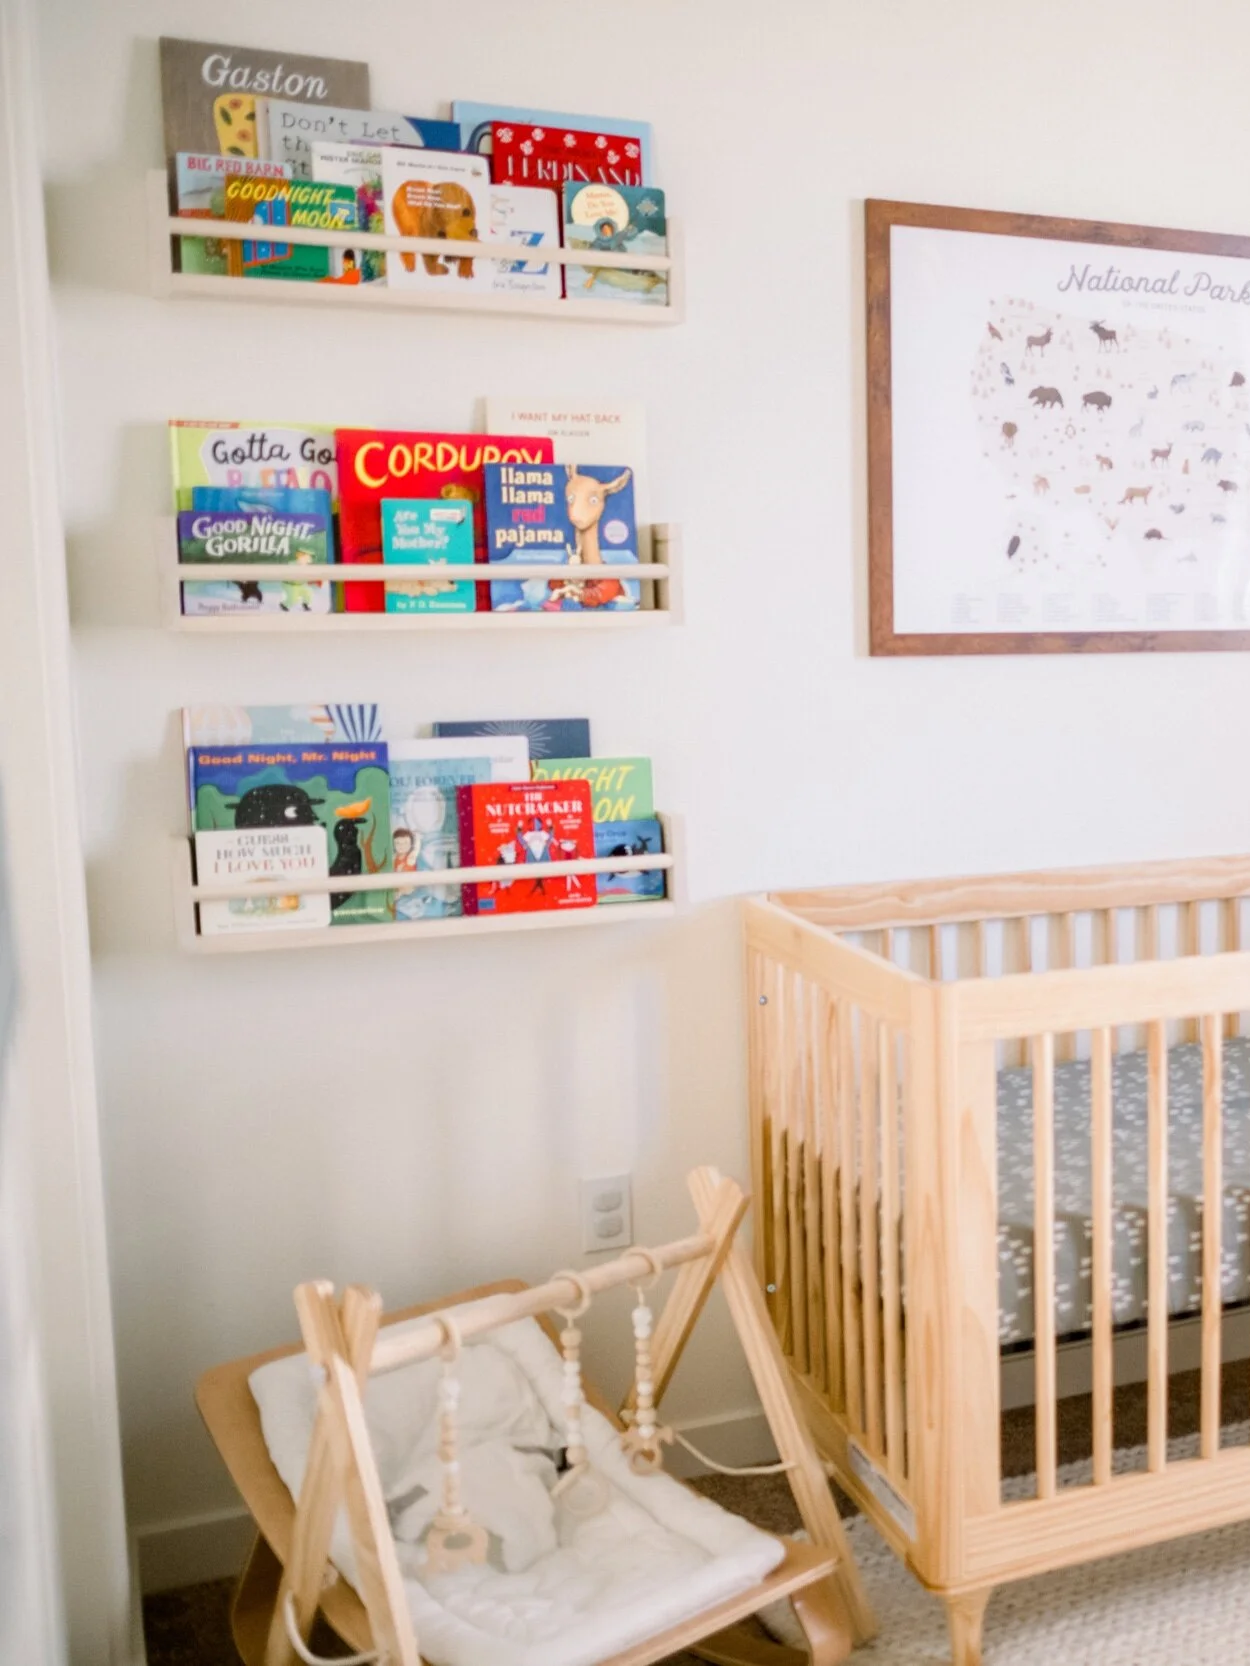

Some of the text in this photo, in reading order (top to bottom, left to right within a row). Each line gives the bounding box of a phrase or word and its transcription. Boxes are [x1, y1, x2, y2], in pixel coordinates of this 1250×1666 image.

[203, 54, 328, 98] Gaston
[281, 112, 400, 141] Don't Let
[282, 135, 312, 152] th
[187, 156, 284, 177] BIG RED BARN
[227, 181, 337, 205] GOODNIGHT
[292, 210, 346, 229] MOON
[1057, 263, 1181, 294] National
[517, 411, 548, 421] WANT
[571, 413, 591, 422] HAT
[594, 414, 621, 424] BACK
[212, 432, 290, 464] Gotta
[354, 441, 543, 488] CORDUROY
[501, 466, 553, 486] llama
[502, 486, 554, 505] llama
[512, 505, 546, 523] red
[192, 516, 247, 540] GOOD
[495, 524, 564, 548] pajama
[205, 536, 290, 557] GORILLA
[198, 752, 243, 766] Good
[332, 750, 377, 762] Night
[485, 800, 583, 816] NUTCRACKER
[594, 795, 635, 823] ON
[216, 844, 312, 860] HOW MUCH
[228, 859, 275, 873] LOVE
[280, 856, 316, 871] YOU
